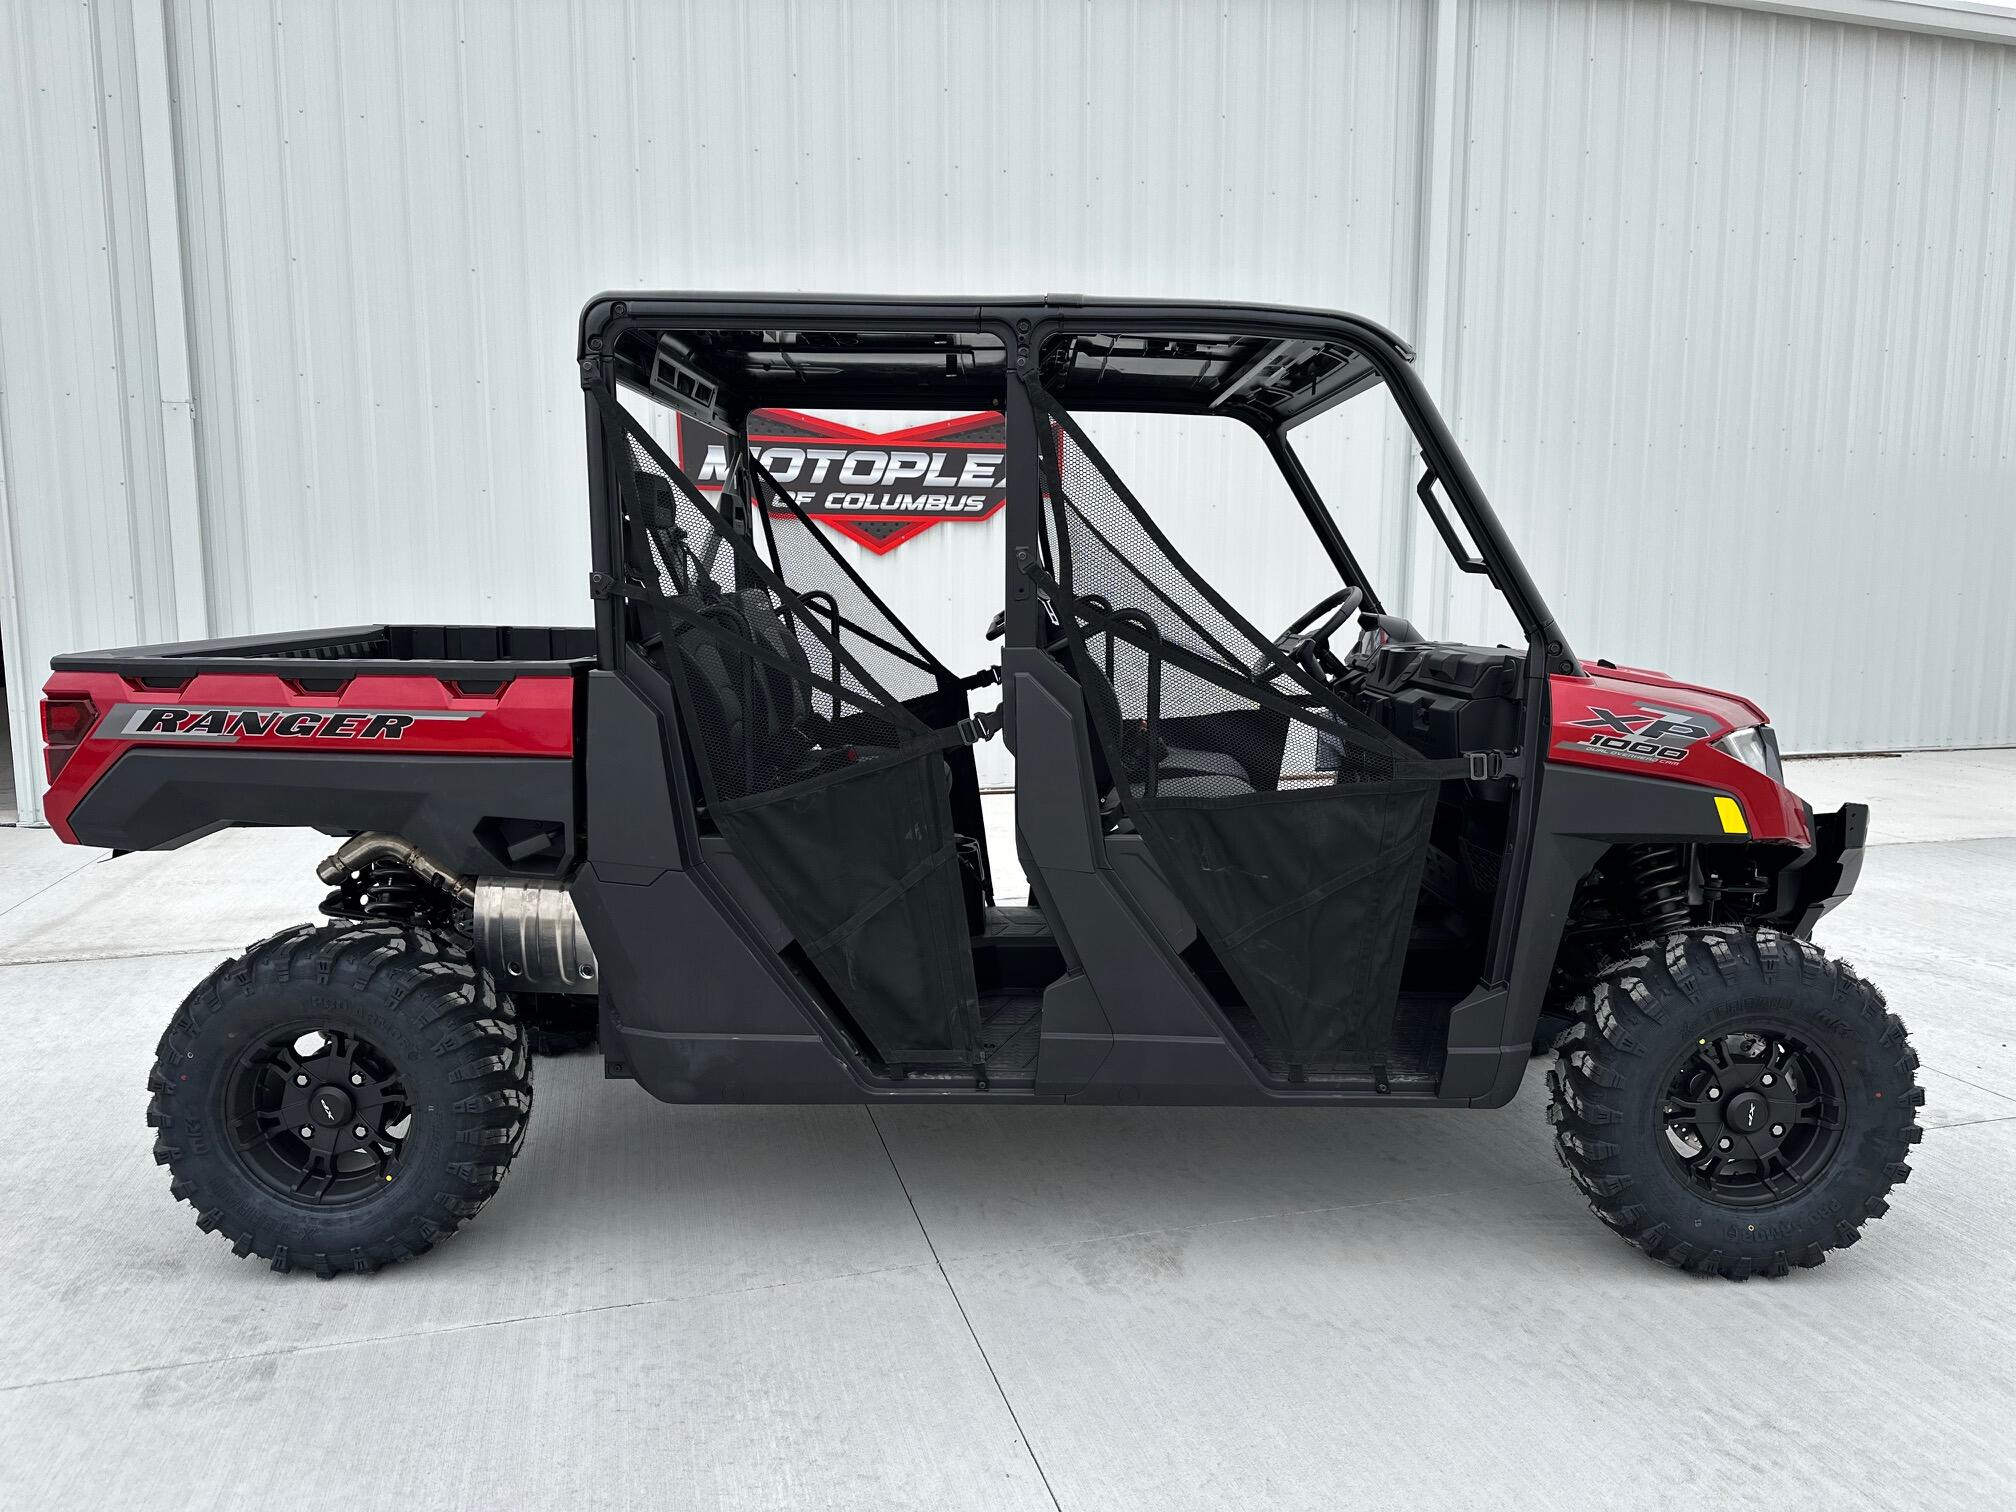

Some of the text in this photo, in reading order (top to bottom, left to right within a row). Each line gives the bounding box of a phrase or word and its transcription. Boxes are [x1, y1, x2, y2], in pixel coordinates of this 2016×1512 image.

[698, 445, 1006, 488] MOTOPLE
[824, 492, 986, 512] COLUMBUS
[134, 708, 415, 739] RANGER
[1560, 705, 1711, 740] XP
[1585, 746, 1609, 754] DUAL
[1588, 733, 1690, 762] 1000
